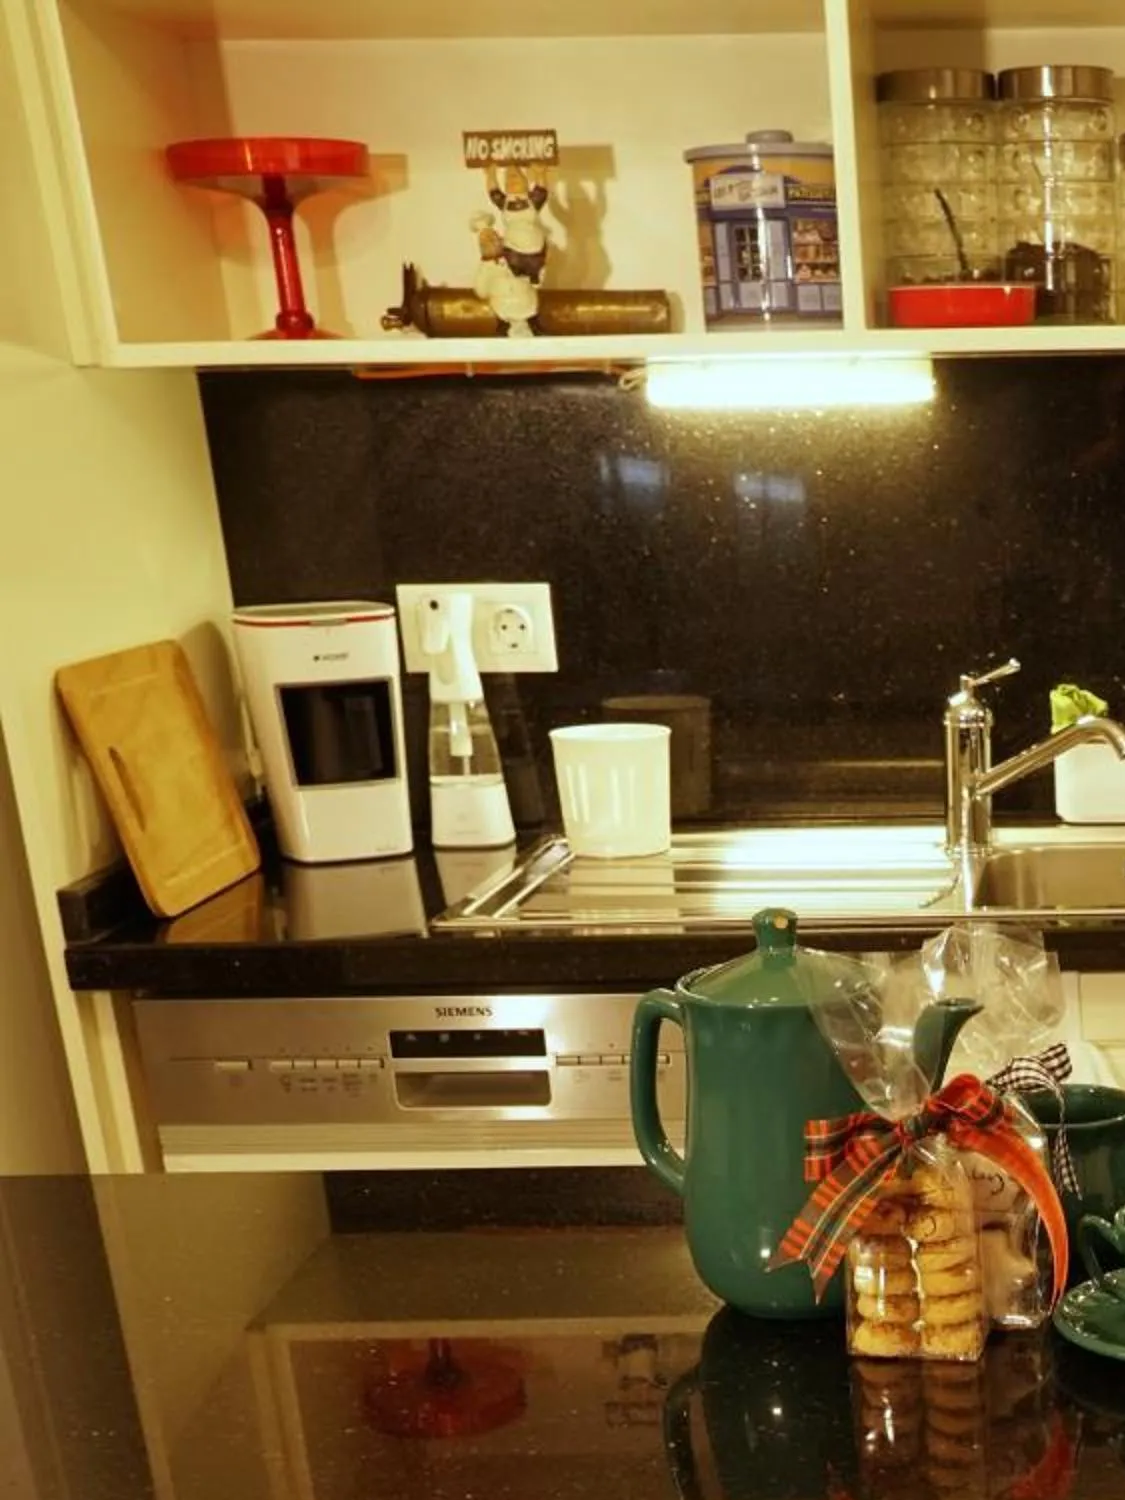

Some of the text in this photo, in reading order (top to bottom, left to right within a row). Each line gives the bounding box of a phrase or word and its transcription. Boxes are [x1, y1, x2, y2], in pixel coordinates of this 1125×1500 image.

[465, 134, 555, 160] NO SMOKING
[435, 1007, 493, 1018] SIEMENS
